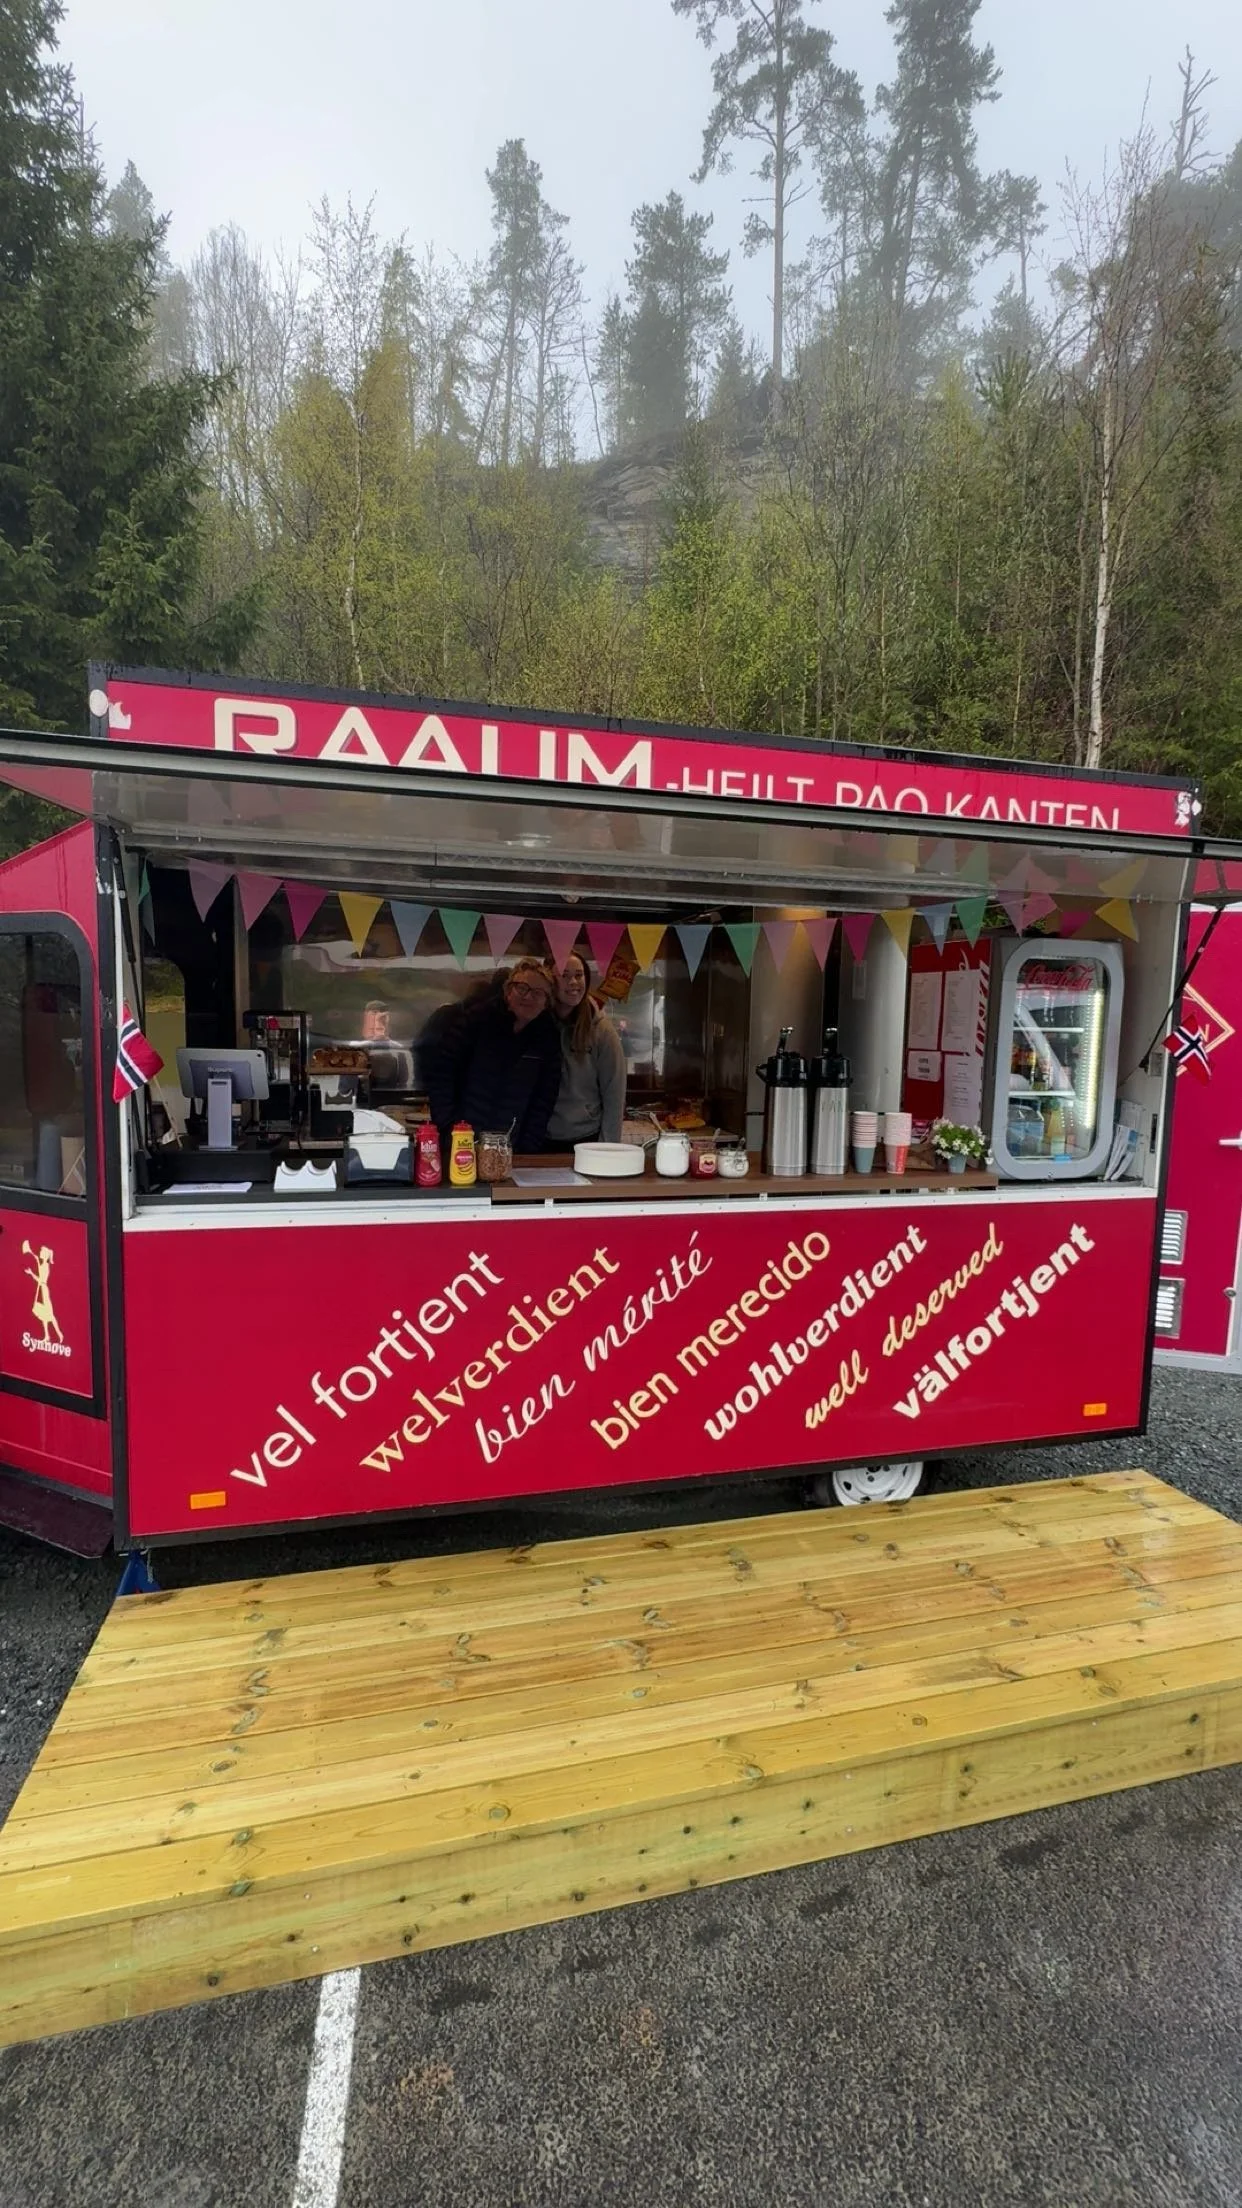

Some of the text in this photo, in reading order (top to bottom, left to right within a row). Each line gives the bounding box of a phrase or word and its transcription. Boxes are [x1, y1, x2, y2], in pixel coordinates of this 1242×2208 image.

[22, 1331, 72, 1358] Synnøve
[230, 1250, 505, 1488] vel fortjent
[359, 1246, 621, 1473] welverdient
[475, 1230, 713, 1464] bien mérité
[590, 1231, 831, 1450] bien merecido
[703, 1224, 928, 1441] wohlverdient
[805, 1222, 1004, 1429] well deserved
[892, 1222, 1095, 1419] välfortjent
